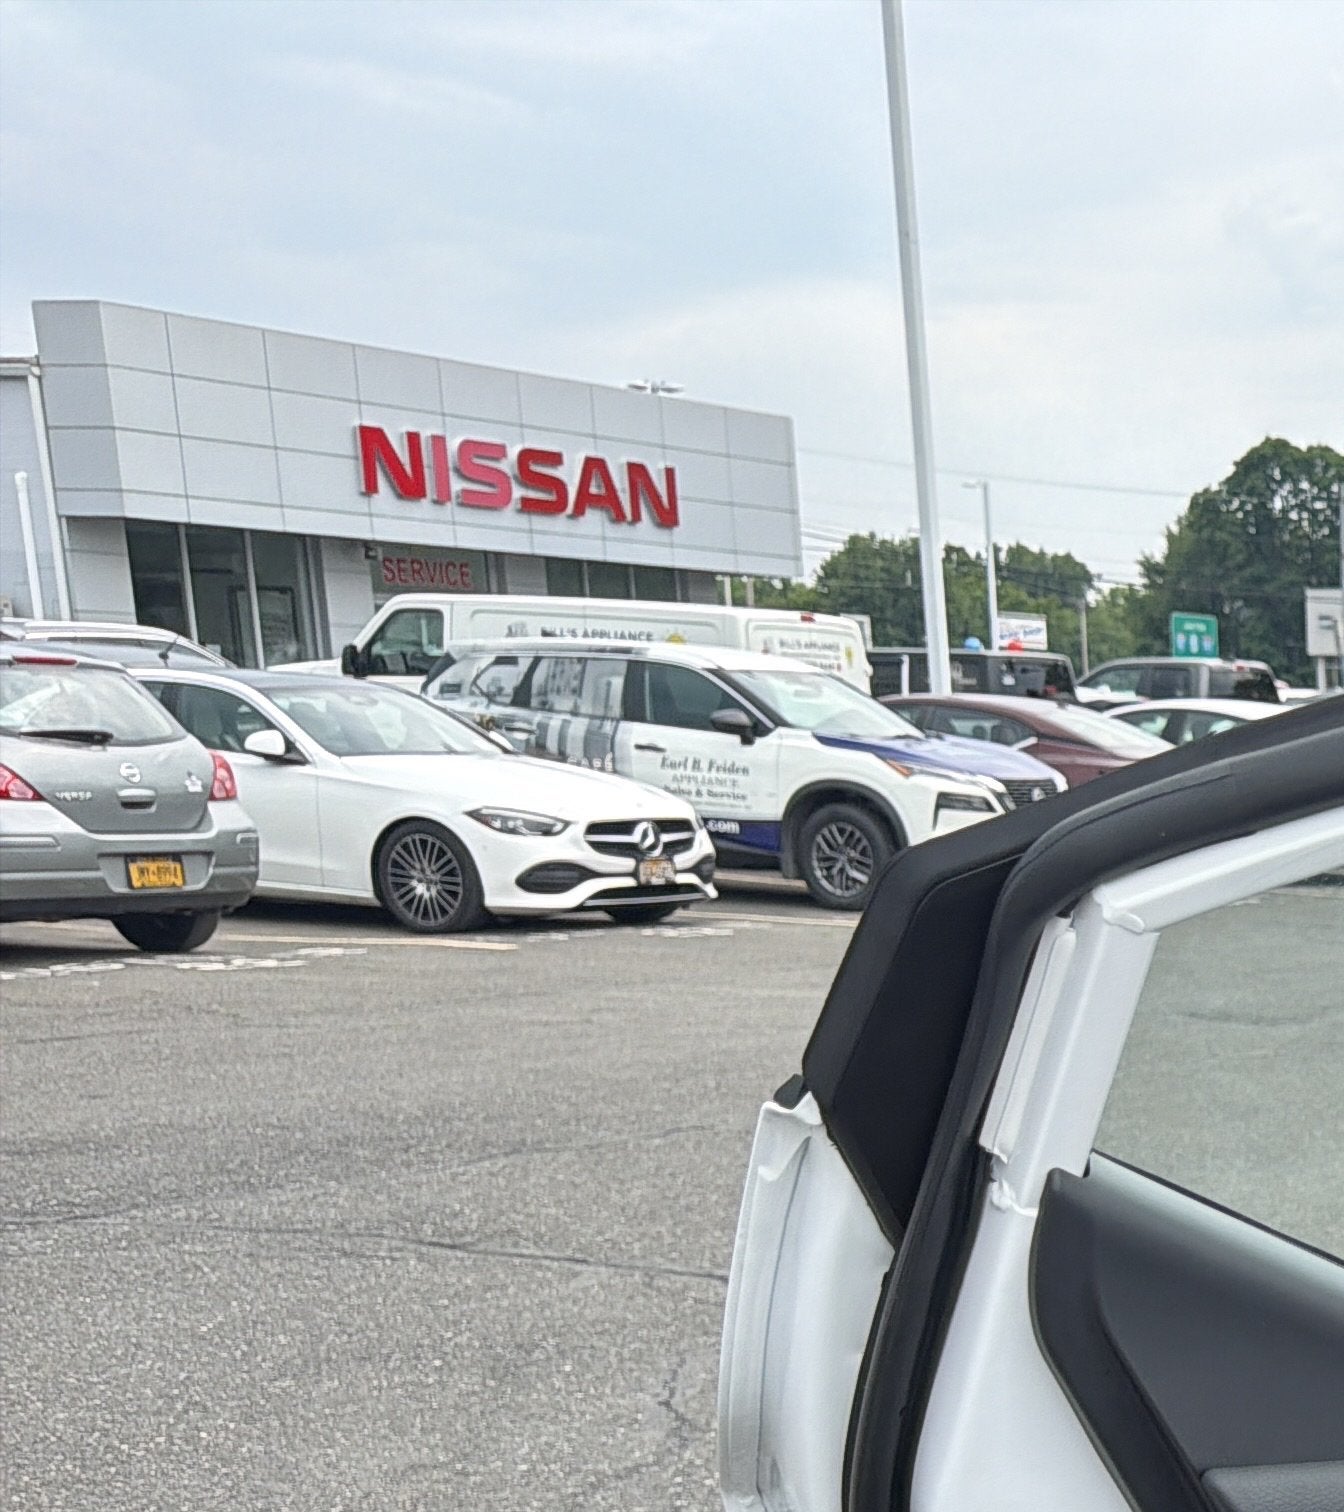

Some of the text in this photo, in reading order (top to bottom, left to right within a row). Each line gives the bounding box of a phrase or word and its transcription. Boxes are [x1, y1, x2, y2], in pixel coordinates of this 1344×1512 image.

[358, 424, 680, 529] NISSAN
[382, 556, 473, 590] SERVICE
[581, 626, 654, 641] APPLIANCE
